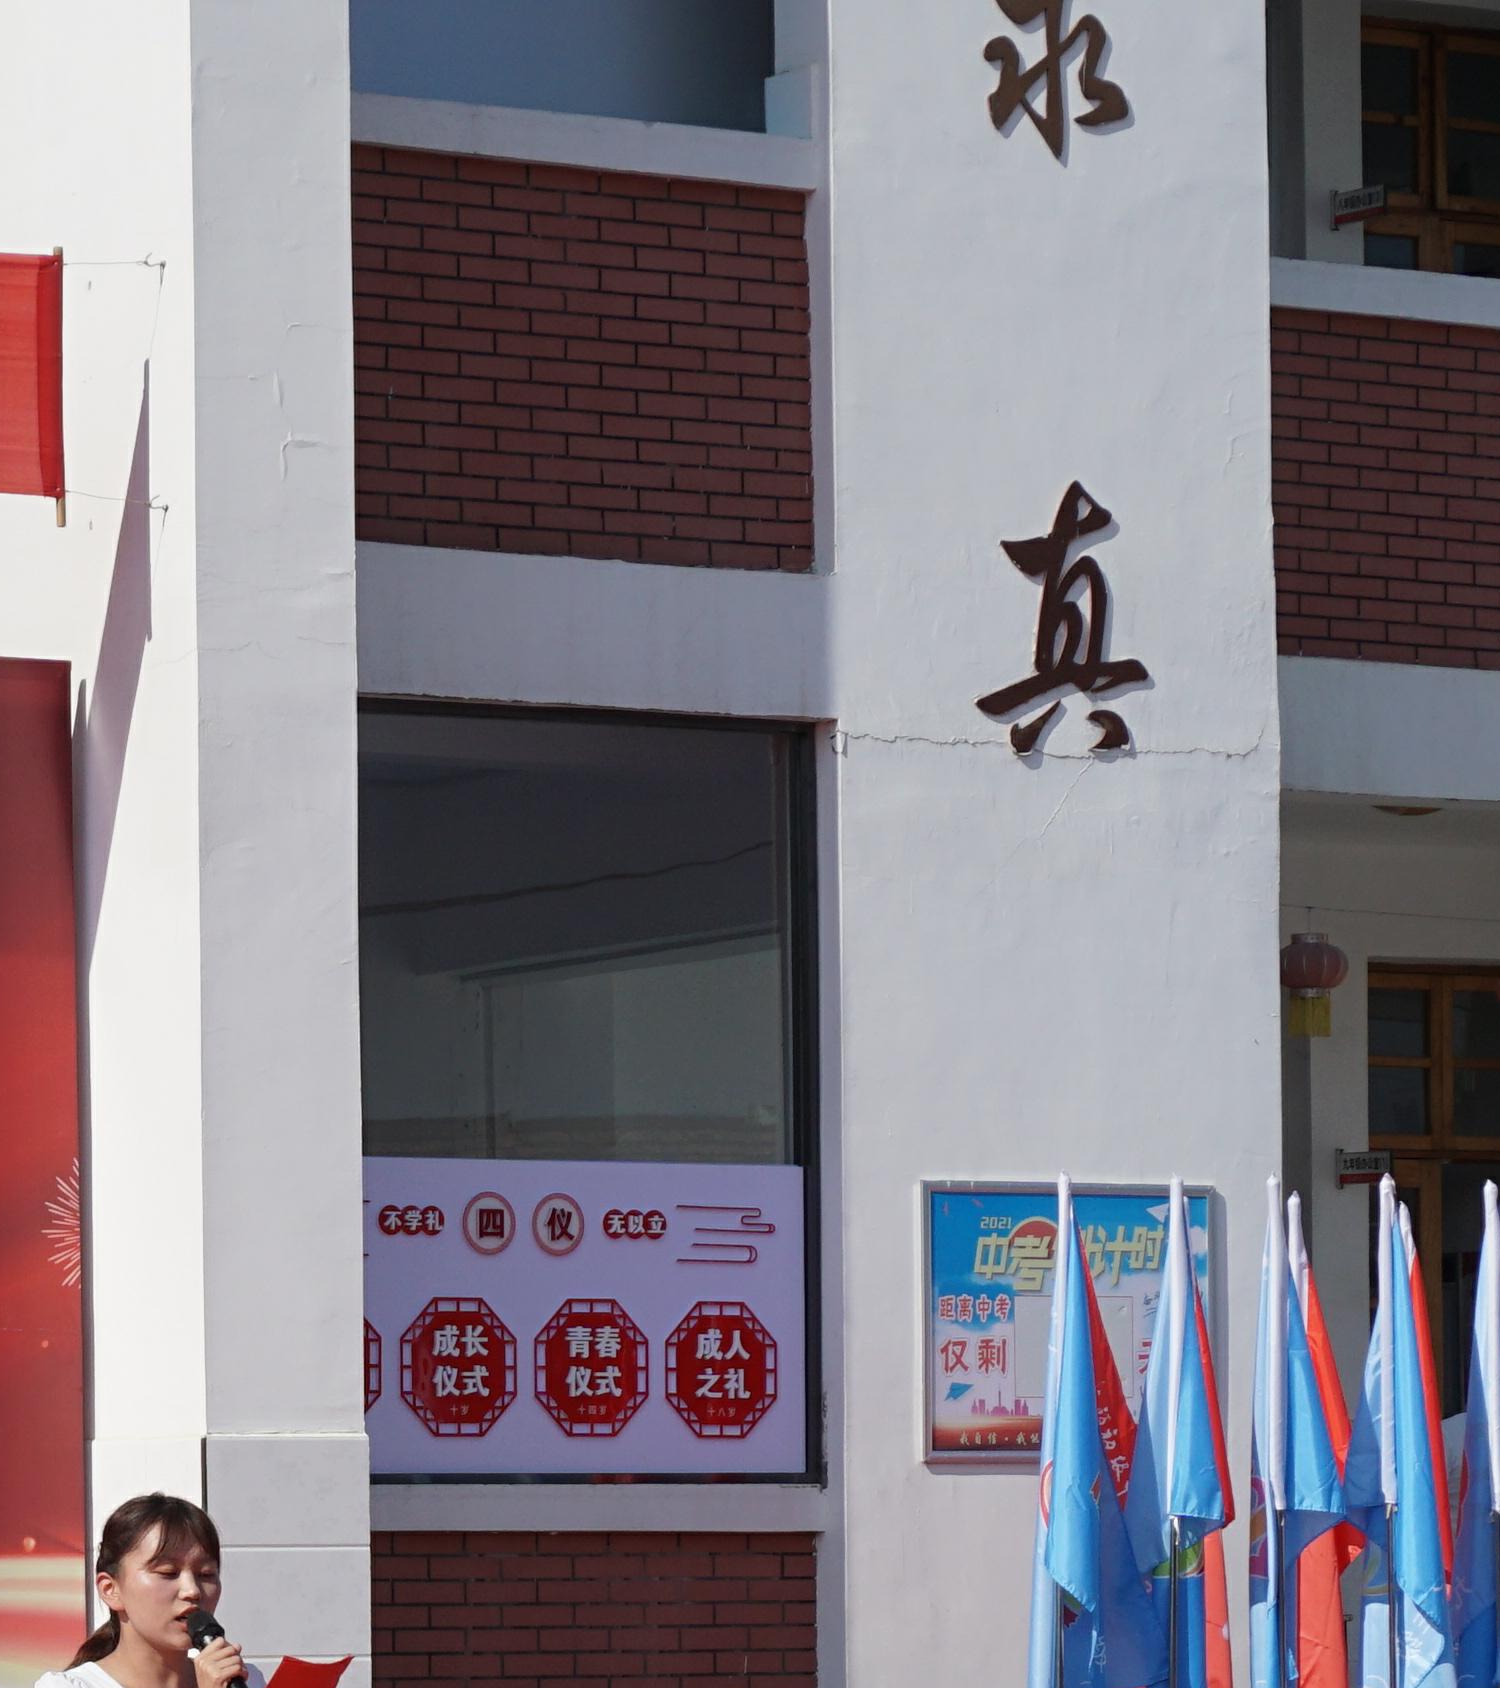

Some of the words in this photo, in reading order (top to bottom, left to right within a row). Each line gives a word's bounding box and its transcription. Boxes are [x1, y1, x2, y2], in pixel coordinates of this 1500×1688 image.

[975, 480, 1148, 751] 真
[383, 1209, 444, 1232] 不学礼
[478, 1208, 505, 1239] 四
[547, 1206, 575, 1242] 仪
[607, 1213, 667, 1235] 无以立
[981, 1216, 1011, 1229] 2021
[939, 1296, 1010, 1321] 距离中考
[432, 1325, 489, 1357] 成长
[565, 1326, 622, 1359] 青春
[696, 1329, 751, 1361] 成人
[940, 1338, 1008, 1375] 仅剩
[432, 1365, 490, 1397] 仪式
[565, 1366, 622, 1397] 仪式
[695, 1369, 751, 1399] 之礼
